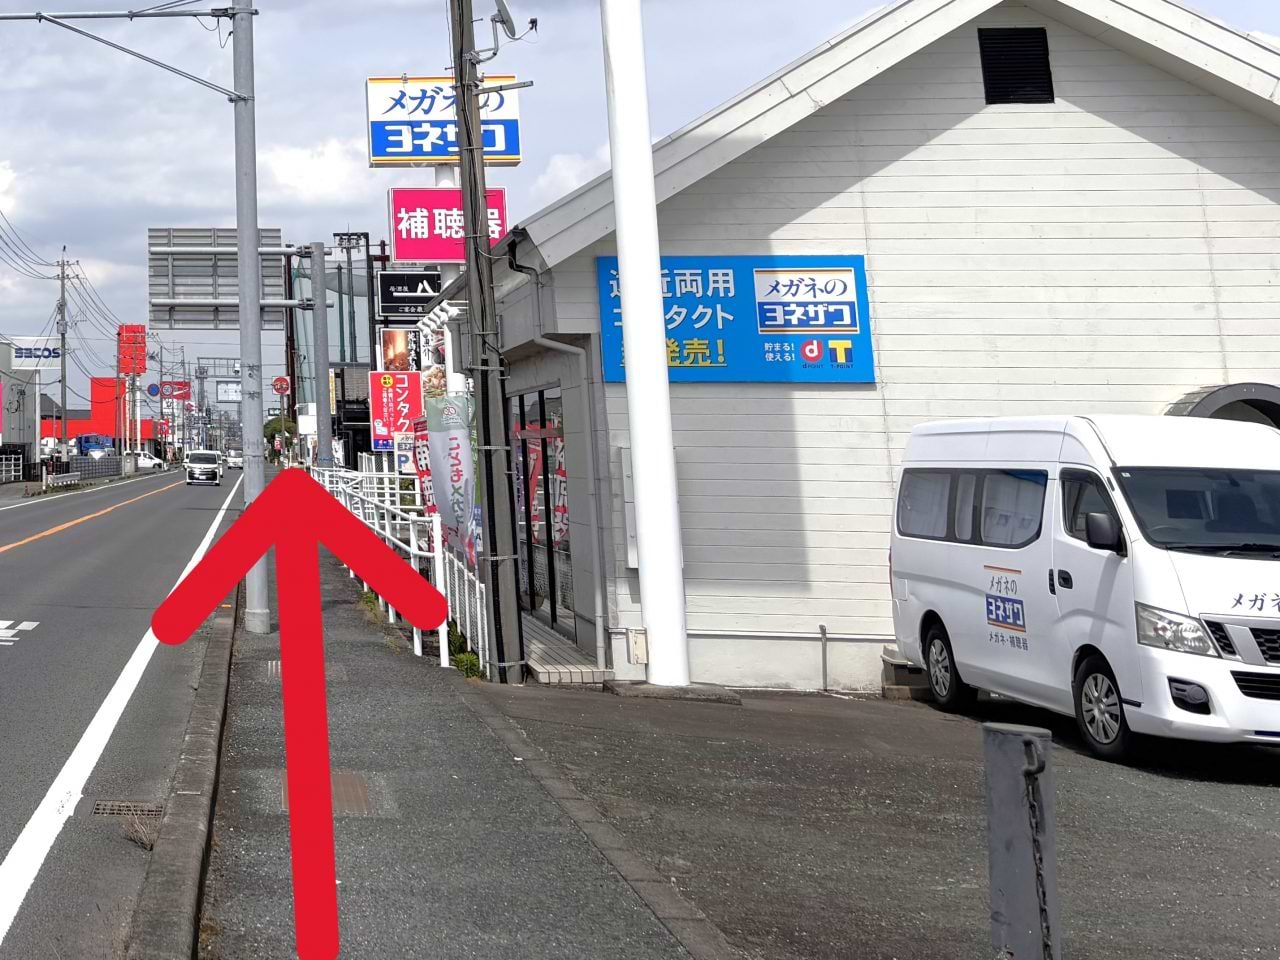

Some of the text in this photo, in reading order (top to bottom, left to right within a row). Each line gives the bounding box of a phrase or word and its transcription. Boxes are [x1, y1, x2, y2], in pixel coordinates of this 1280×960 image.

[764, 277, 848, 299] メガネの
[764, 303, 852, 326] ヨネザワ
[989, 576, 1018, 595] メガネの
[987, 598, 1024, 626] ヨネザワ
